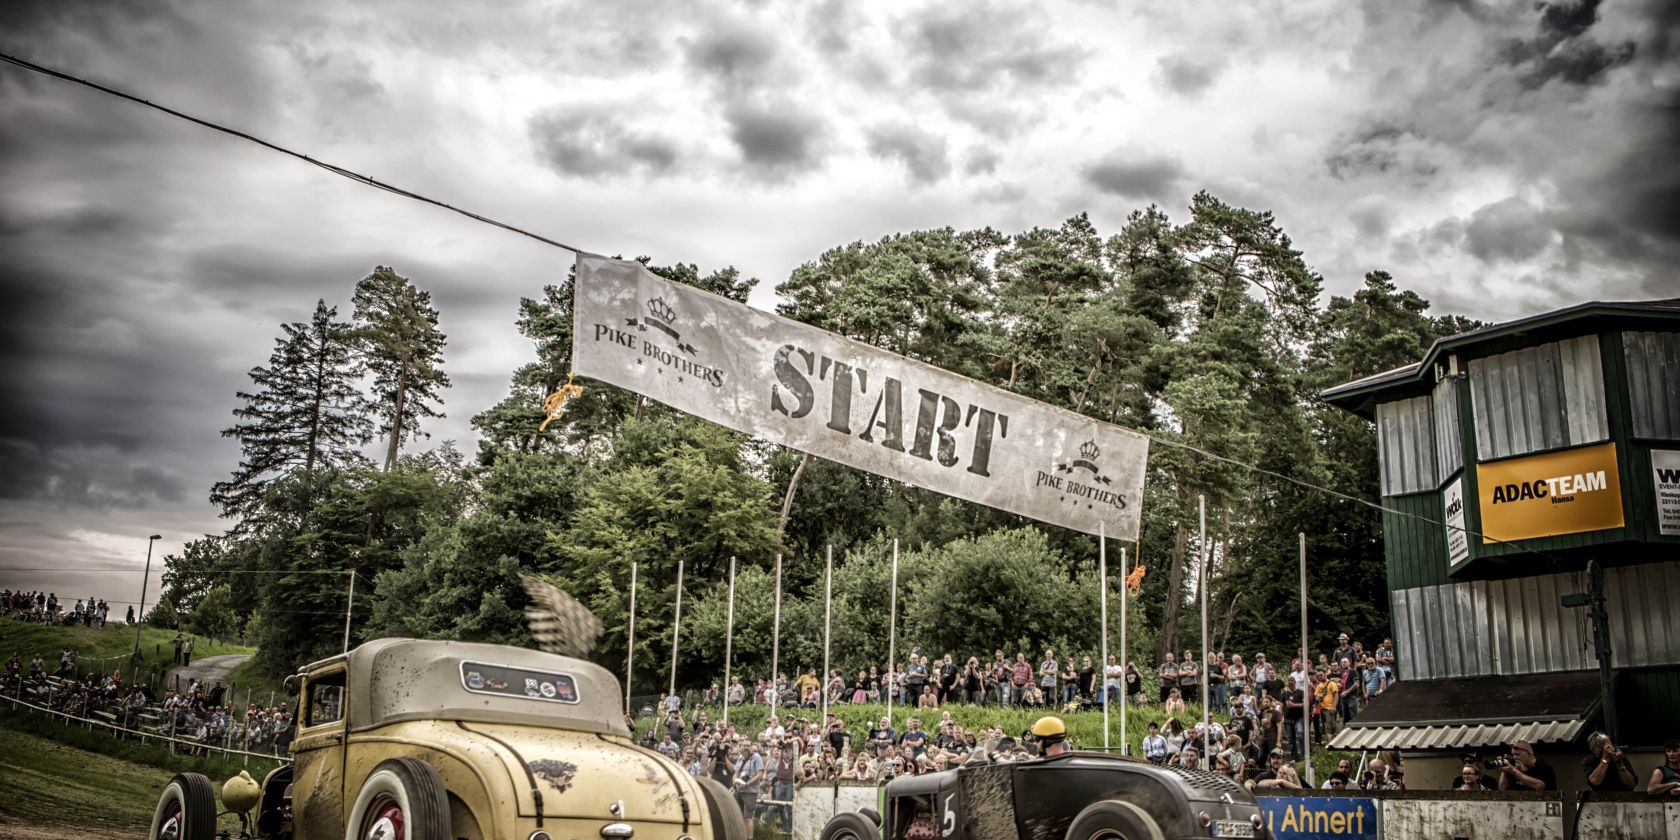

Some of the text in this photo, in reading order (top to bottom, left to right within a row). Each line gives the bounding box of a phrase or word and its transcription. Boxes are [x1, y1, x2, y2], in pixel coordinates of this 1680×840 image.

[593, 323, 724, 388] PIKE BROTHERS
[770, 344, 1009, 478] START
[1036, 470, 1127, 510] PIKE BROTHERS
[1551, 495, 1574, 505] Hansa
[941, 792, 956, 838] 5
[1280, 803, 1364, 835] Ahnert
